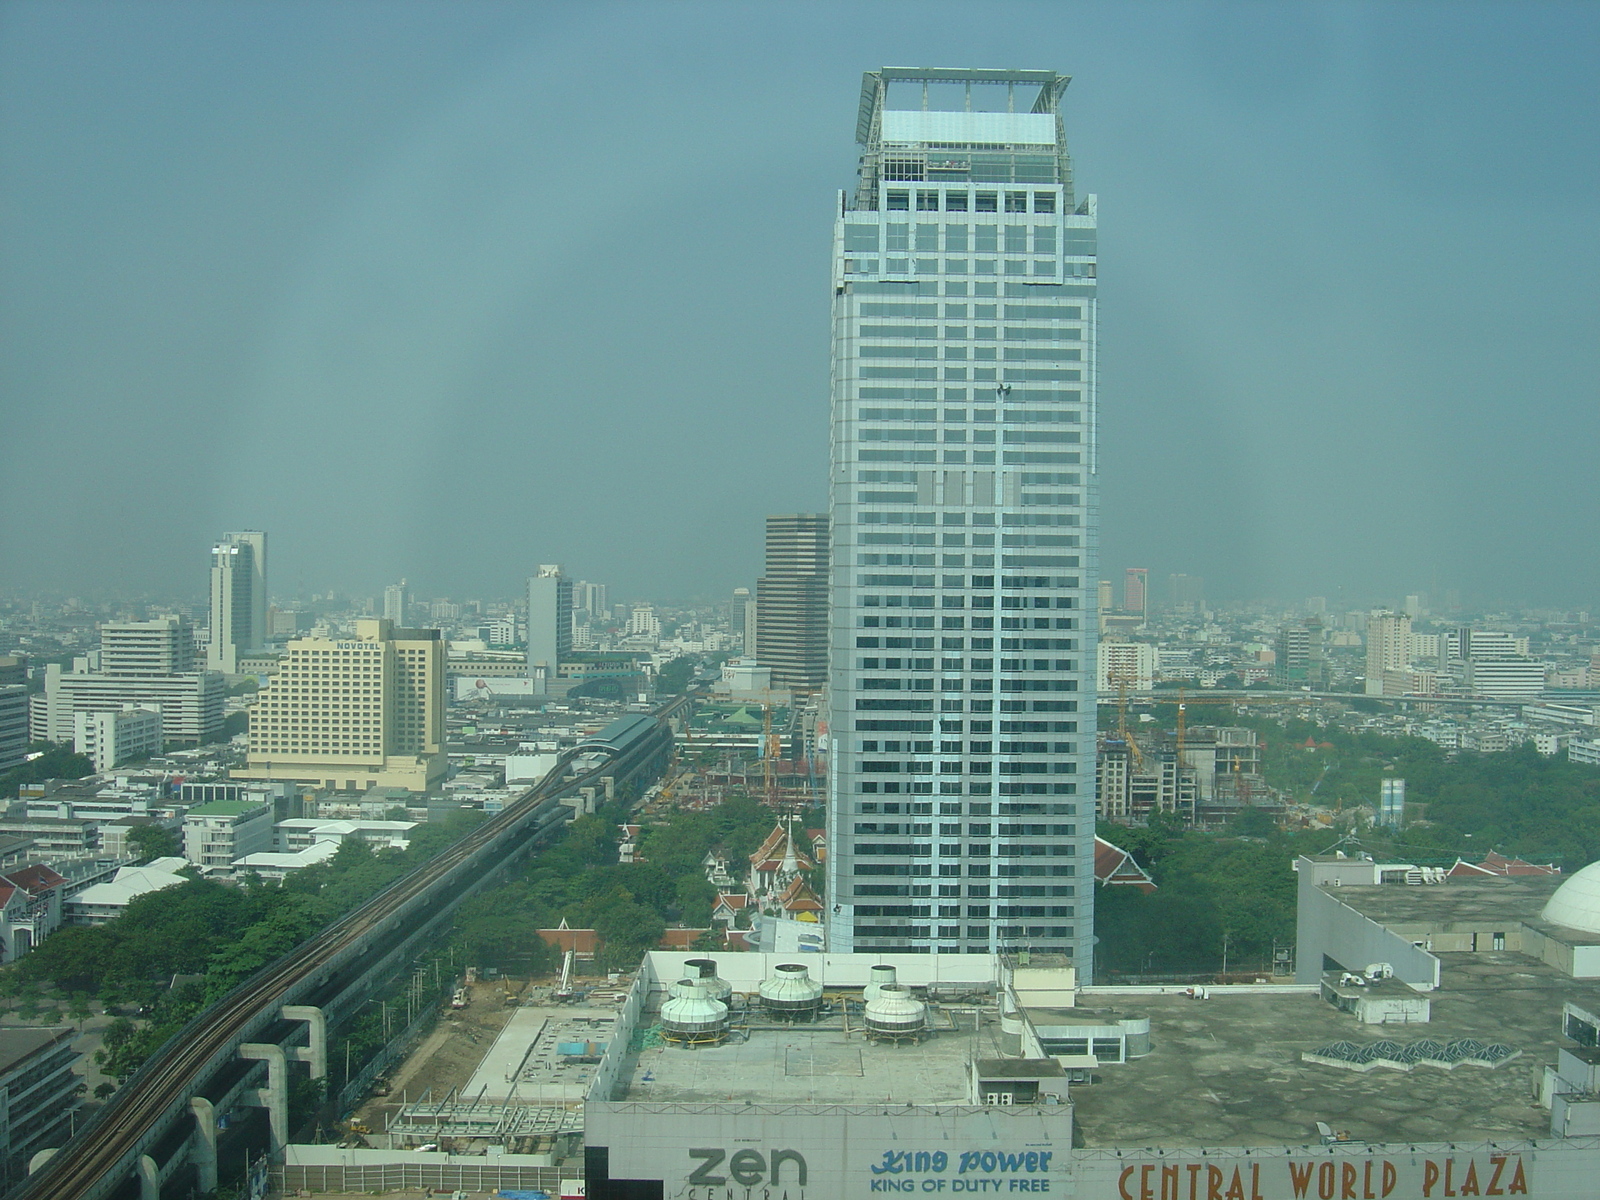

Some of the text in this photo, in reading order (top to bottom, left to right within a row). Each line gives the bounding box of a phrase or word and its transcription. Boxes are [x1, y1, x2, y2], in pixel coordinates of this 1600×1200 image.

[337, 642, 380, 650] NOVOTEL
[689, 1148, 807, 1186] zen
[870, 1150, 949, 1174] King
[870, 1179, 1050, 1193] KING OF DUTY FREE
[1118, 1156, 1528, 1200] CENTRAL WORLD PLAZA
